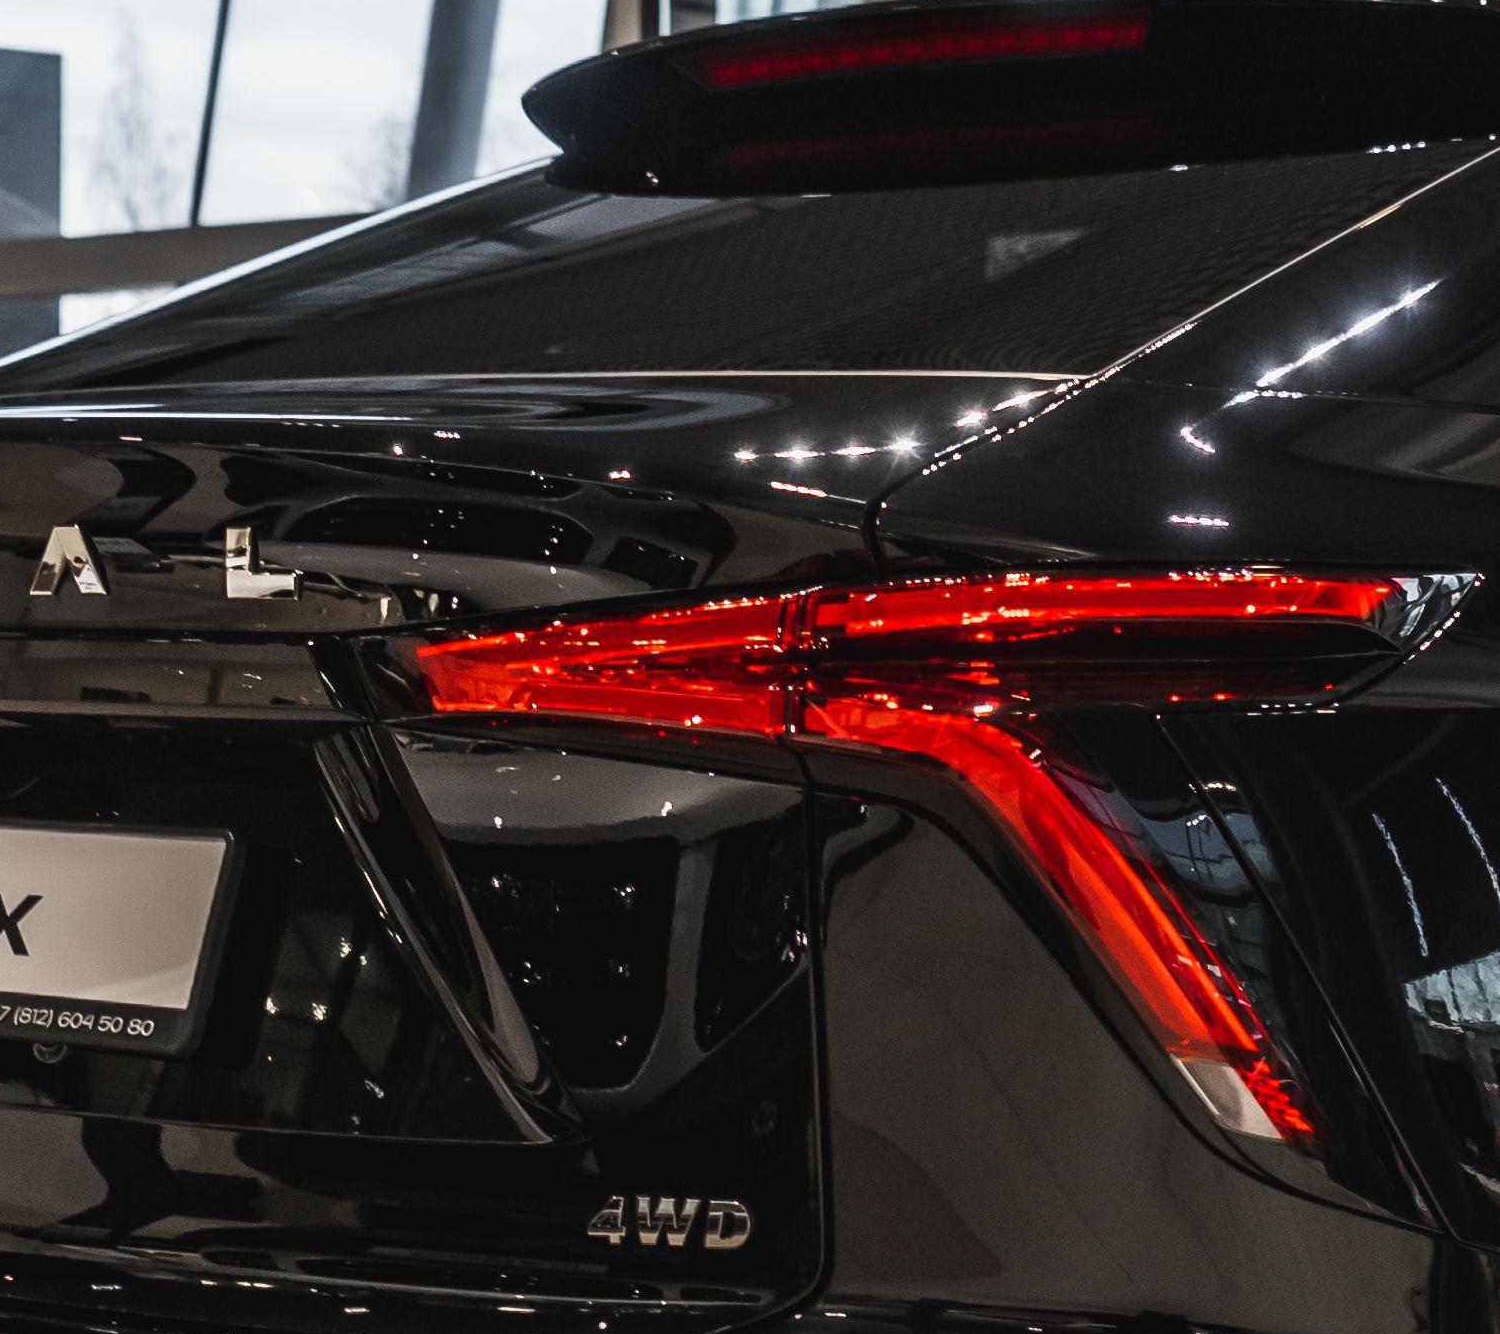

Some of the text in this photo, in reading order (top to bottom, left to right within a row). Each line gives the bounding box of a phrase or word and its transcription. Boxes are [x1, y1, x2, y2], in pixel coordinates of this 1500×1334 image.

[13, 1006, 53, 1028] (812)
[57, 1011, 95, 1031] 604
[97, 1016, 124, 1034] 50
[127, 1019, 155, 1037] 80
[587, 1195, 752, 1249] 4WD
